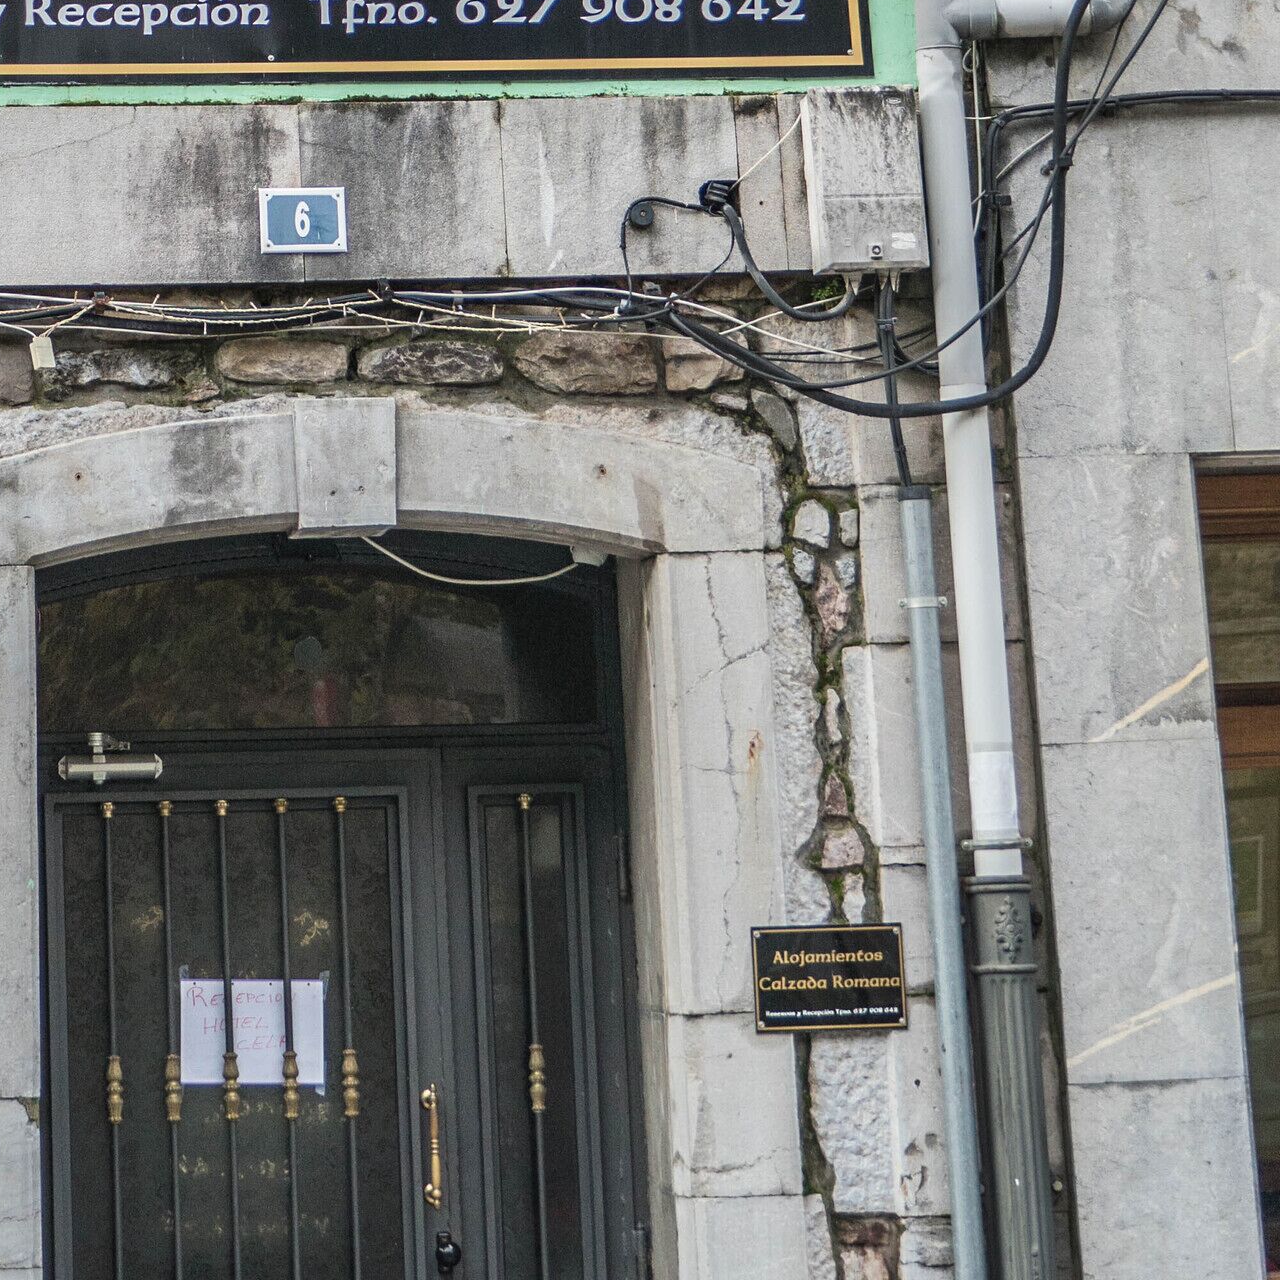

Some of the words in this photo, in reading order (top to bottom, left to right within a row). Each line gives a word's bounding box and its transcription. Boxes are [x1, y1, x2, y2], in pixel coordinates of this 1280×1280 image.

[295, 201, 310, 237] 6
[773, 950, 883, 966] Alojamientos
[759, 976, 827, 990] Calzada
[832, 975, 900, 988] Romana
